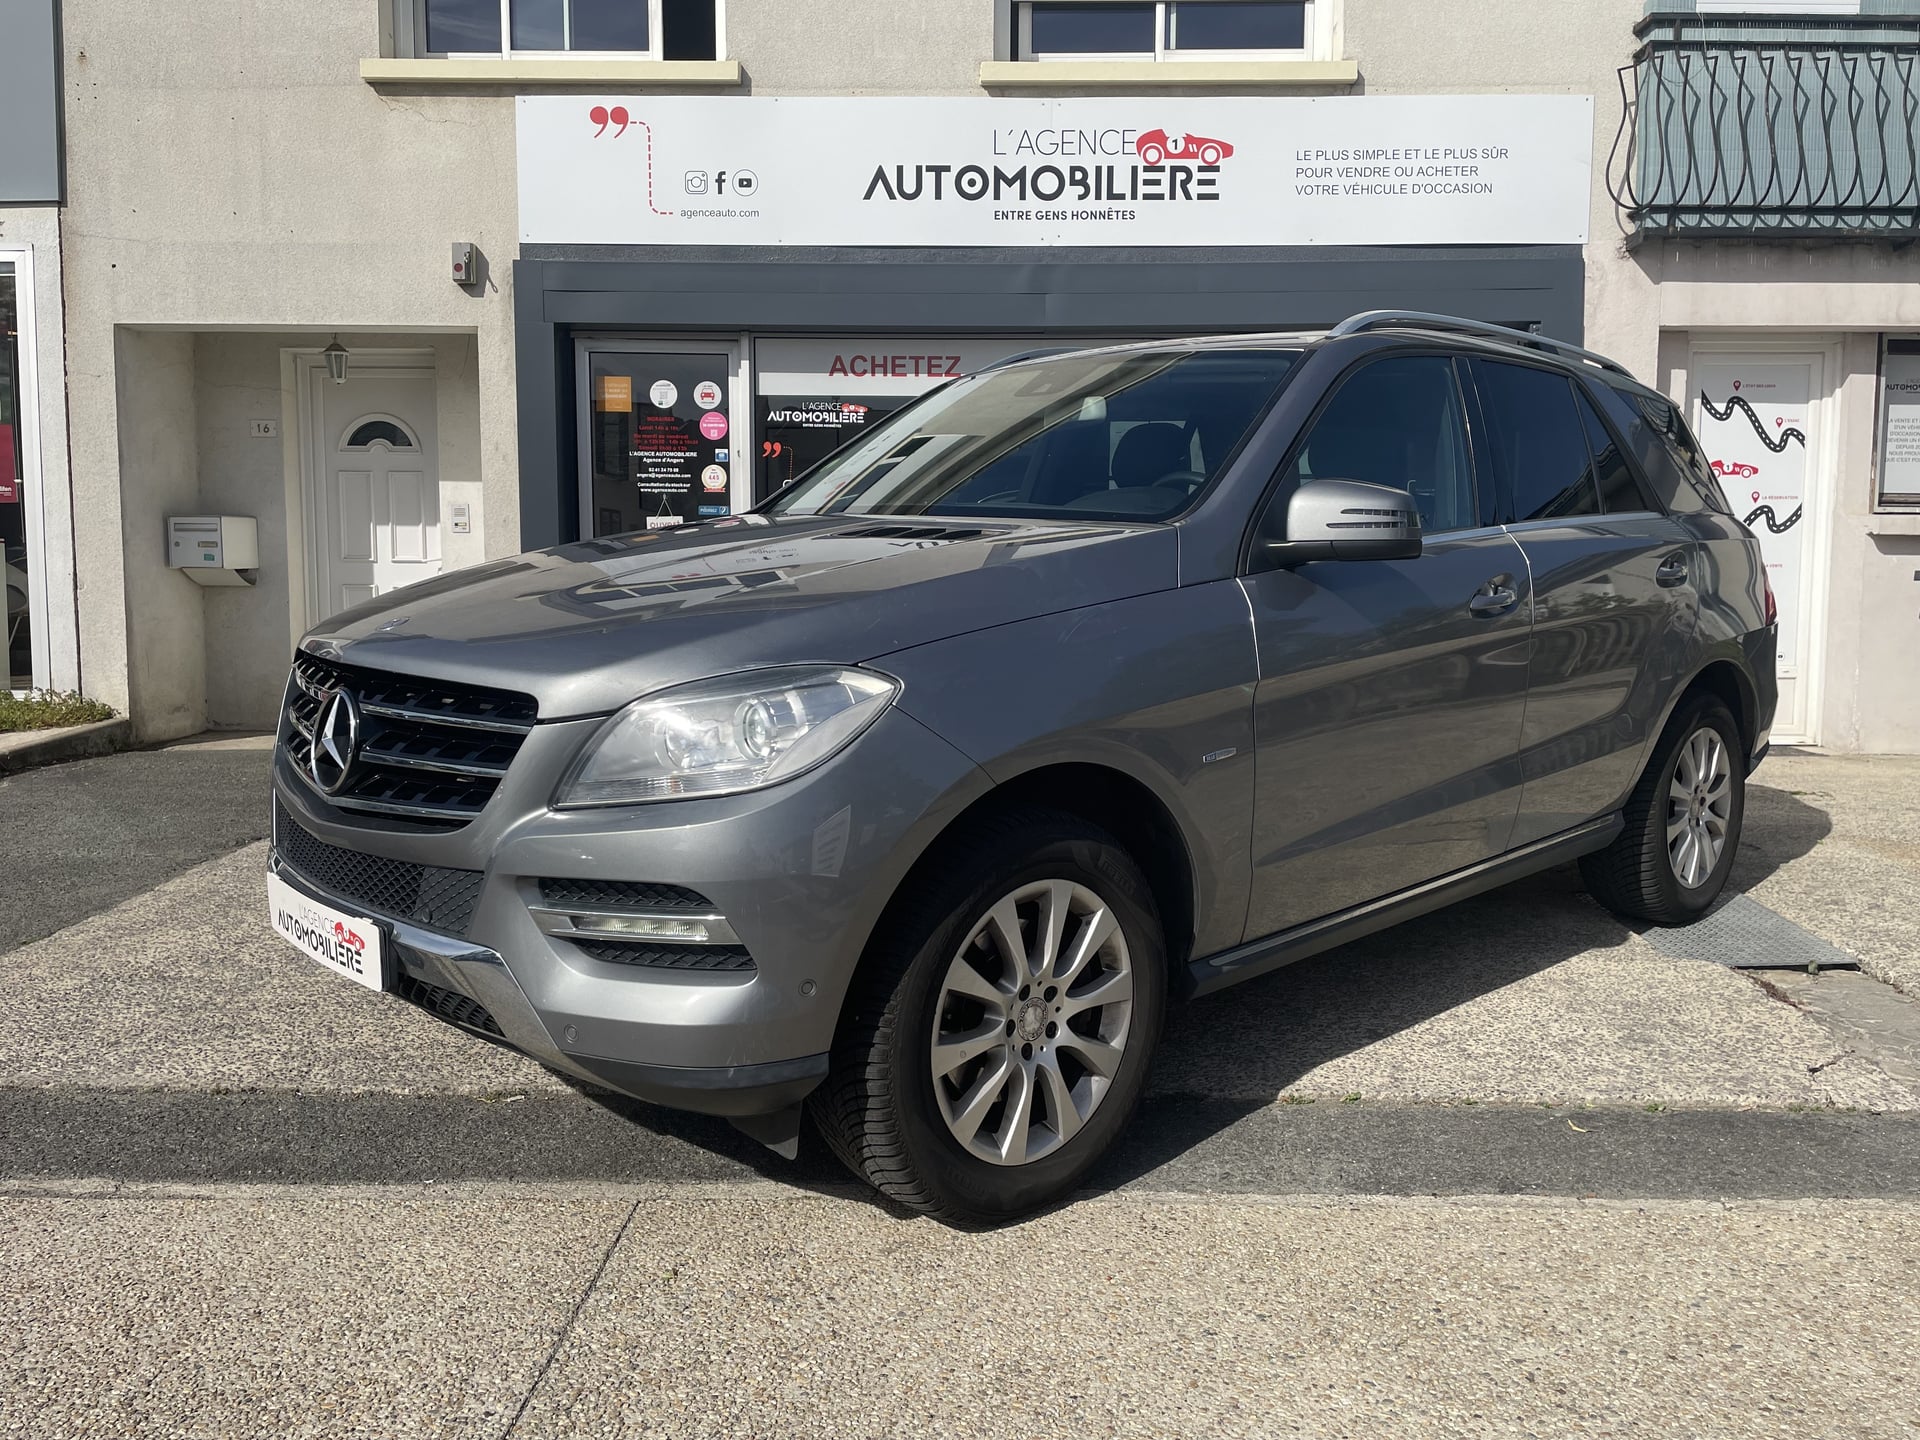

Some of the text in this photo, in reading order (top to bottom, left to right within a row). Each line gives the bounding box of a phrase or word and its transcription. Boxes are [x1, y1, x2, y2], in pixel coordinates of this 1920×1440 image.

[993, 129, 1137, 155] L'AGENCE
[1296, 146, 1509, 161] LE PLUS SIMPLE ET LE PLUS SÛR
[1296, 165, 1479, 178] POUR VENDRE OU ACHETER
[1295, 182, 1493, 196] VOTRE VÉHICULE D'OCCASION
[680, 208, 760, 219] agenceauto.com
[994, 207, 1136, 220] ENTRE GENS HONNÊTES
[828, 354, 962, 378] ACHETEZ
[802, 401, 842, 411] L'AGENCE
[257, 423, 270, 434] 16
